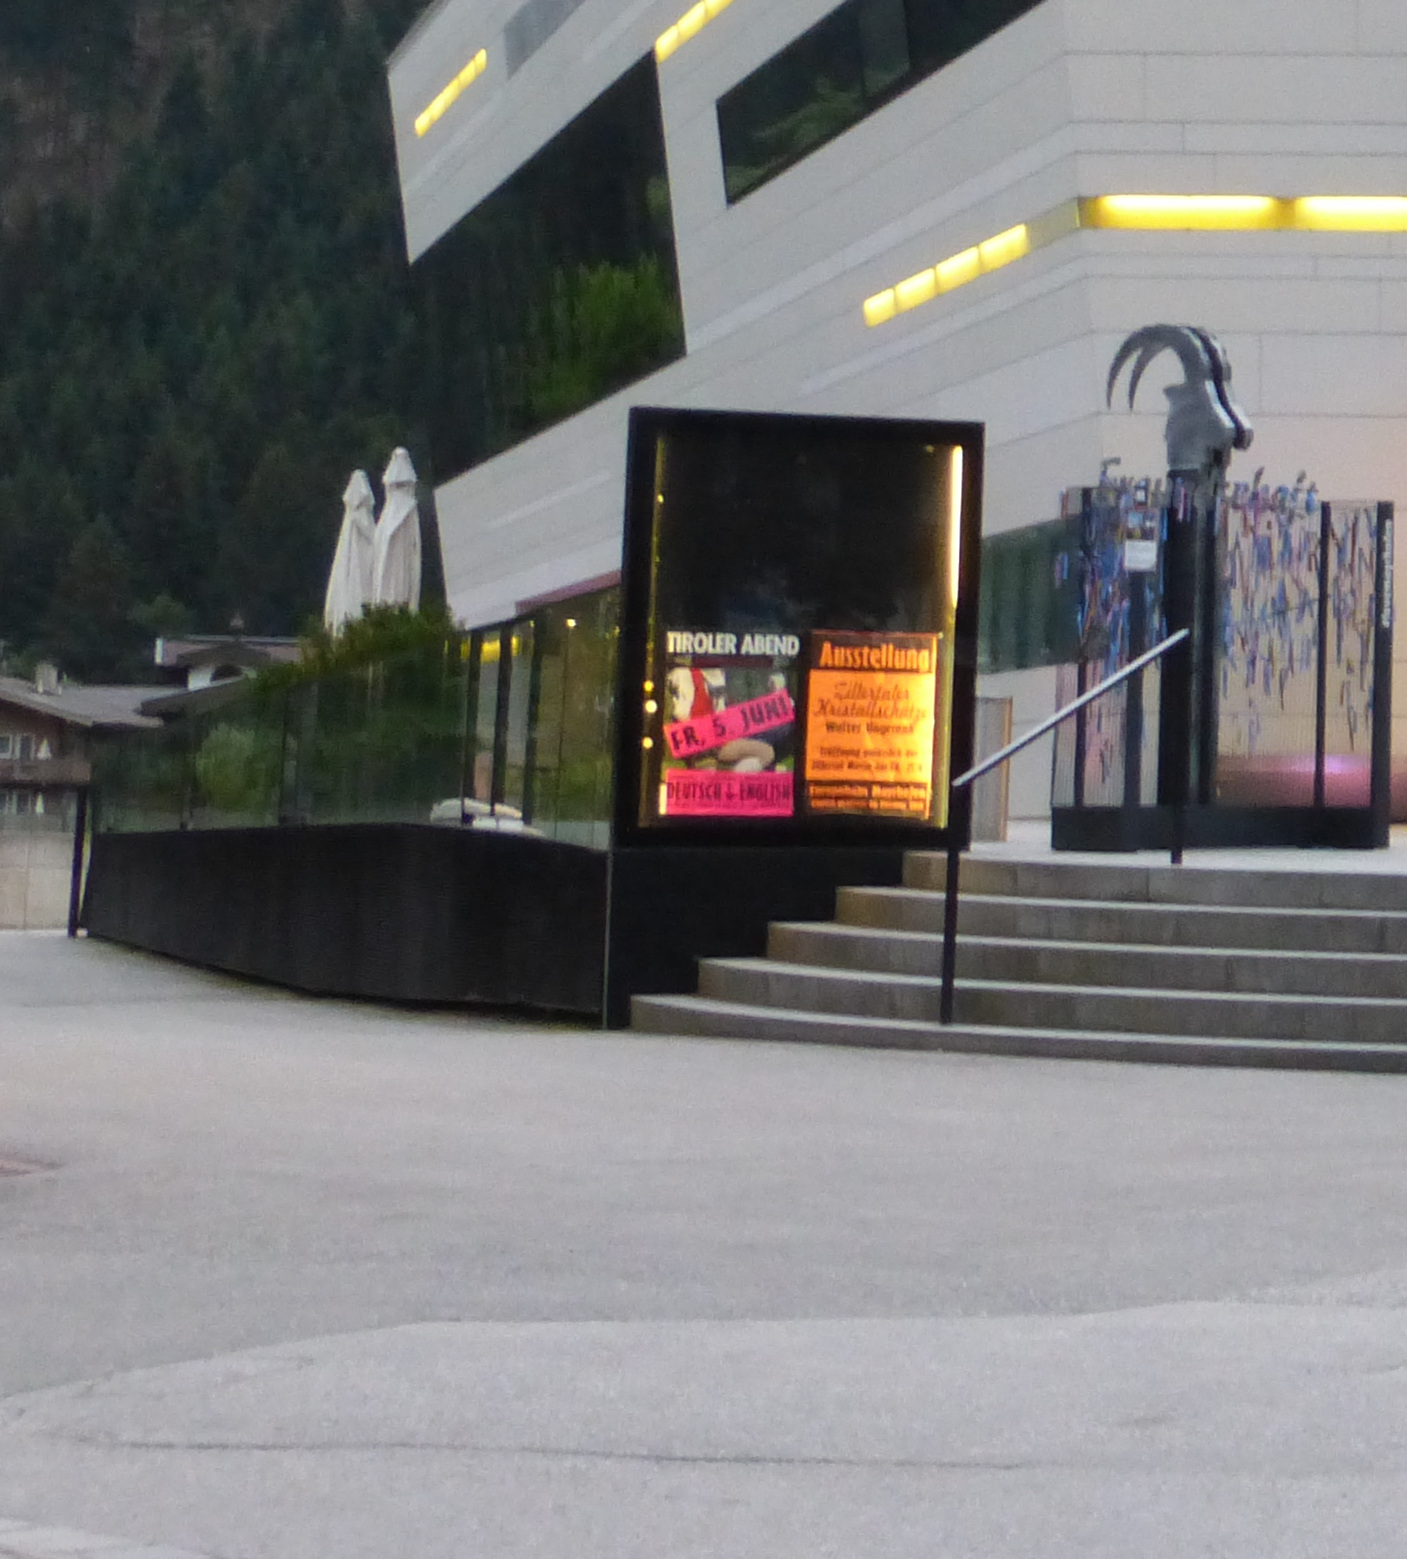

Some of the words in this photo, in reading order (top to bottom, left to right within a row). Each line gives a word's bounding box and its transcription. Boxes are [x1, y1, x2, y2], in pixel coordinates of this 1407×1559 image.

[667, 631, 737, 654] TIROLER
[740, 633, 800, 656] ABEND
[819, 641, 930, 673] Ausstellung
